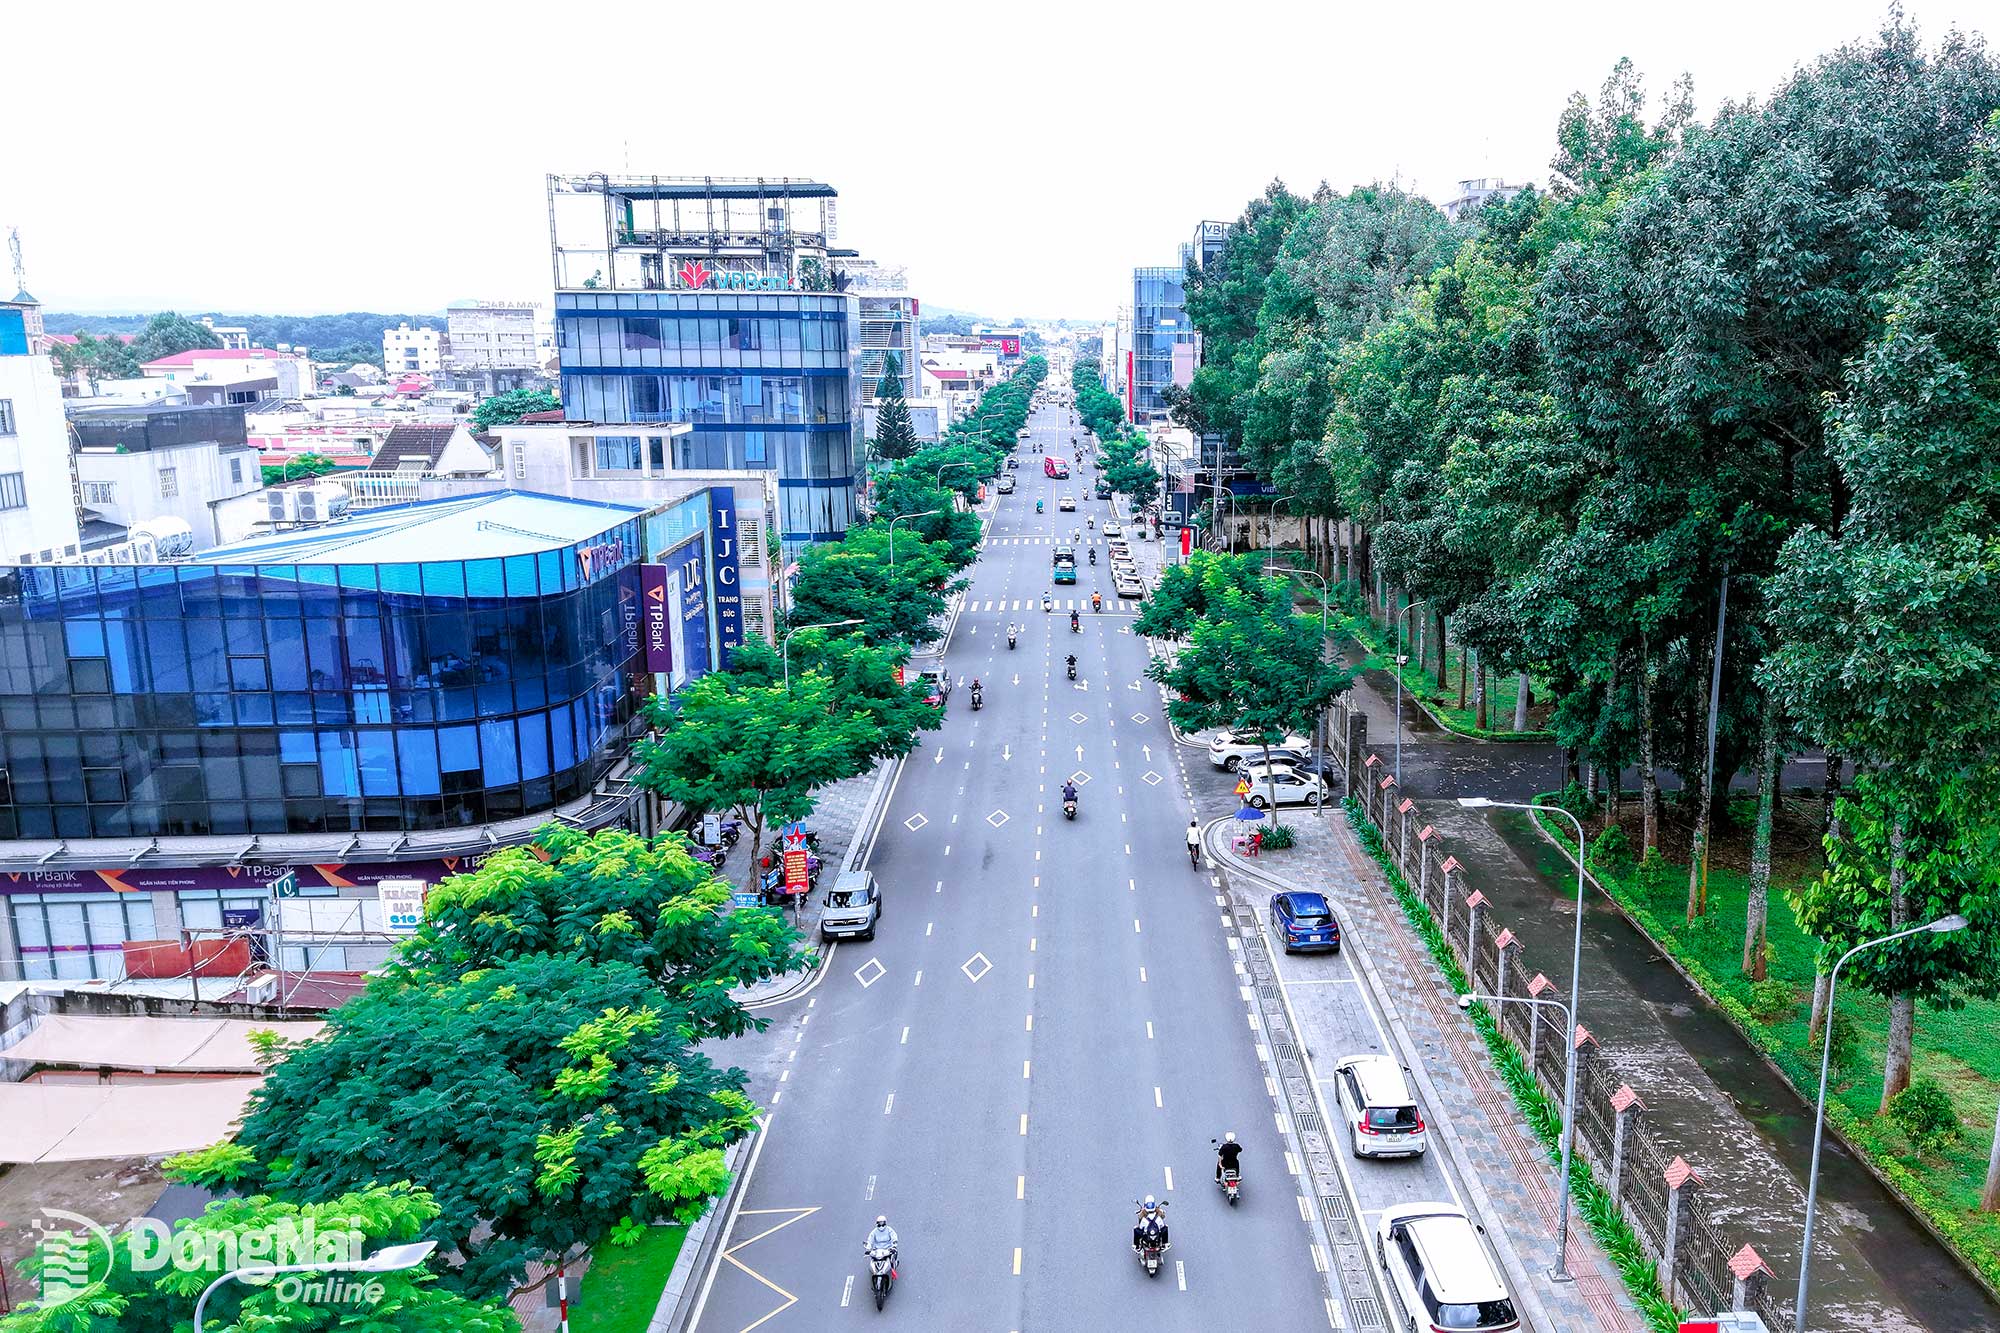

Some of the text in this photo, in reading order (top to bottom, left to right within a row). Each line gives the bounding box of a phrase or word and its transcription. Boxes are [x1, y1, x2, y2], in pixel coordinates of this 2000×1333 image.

[715, 271, 794, 291] VPBank
[717, 509, 735, 585] IJC
[650, 604, 665, 651] TPBank
[27, 869, 77, 881] TPBank
[244, 865, 294, 877] TPBank
[390, 914, 417, 923] 616
